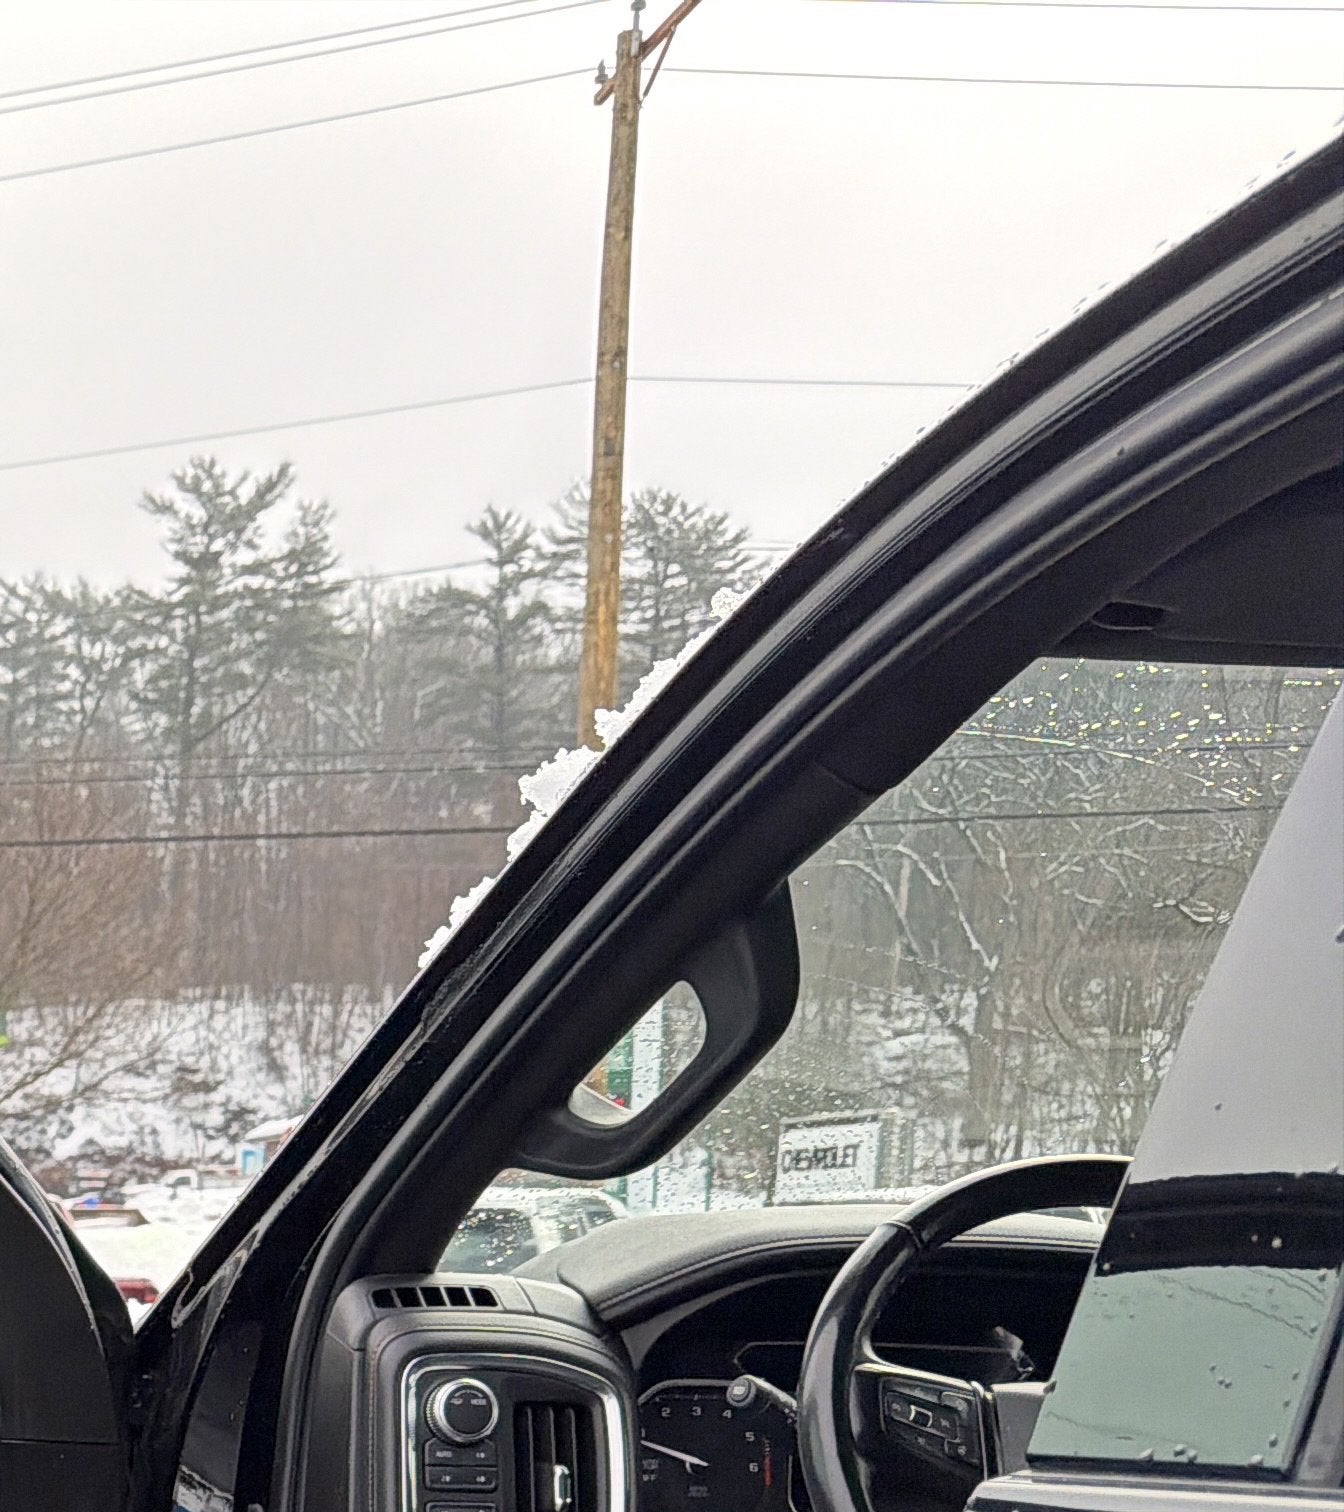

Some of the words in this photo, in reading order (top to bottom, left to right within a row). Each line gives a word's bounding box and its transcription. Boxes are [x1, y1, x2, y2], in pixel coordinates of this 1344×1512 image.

[660, 1406, 671, 1418] 2
[692, 1405, 702, 1416] 3
[722, 1409, 733, 1419] 4
[745, 1431, 755, 1442] 5
[749, 1462, 759, 1473] 6
